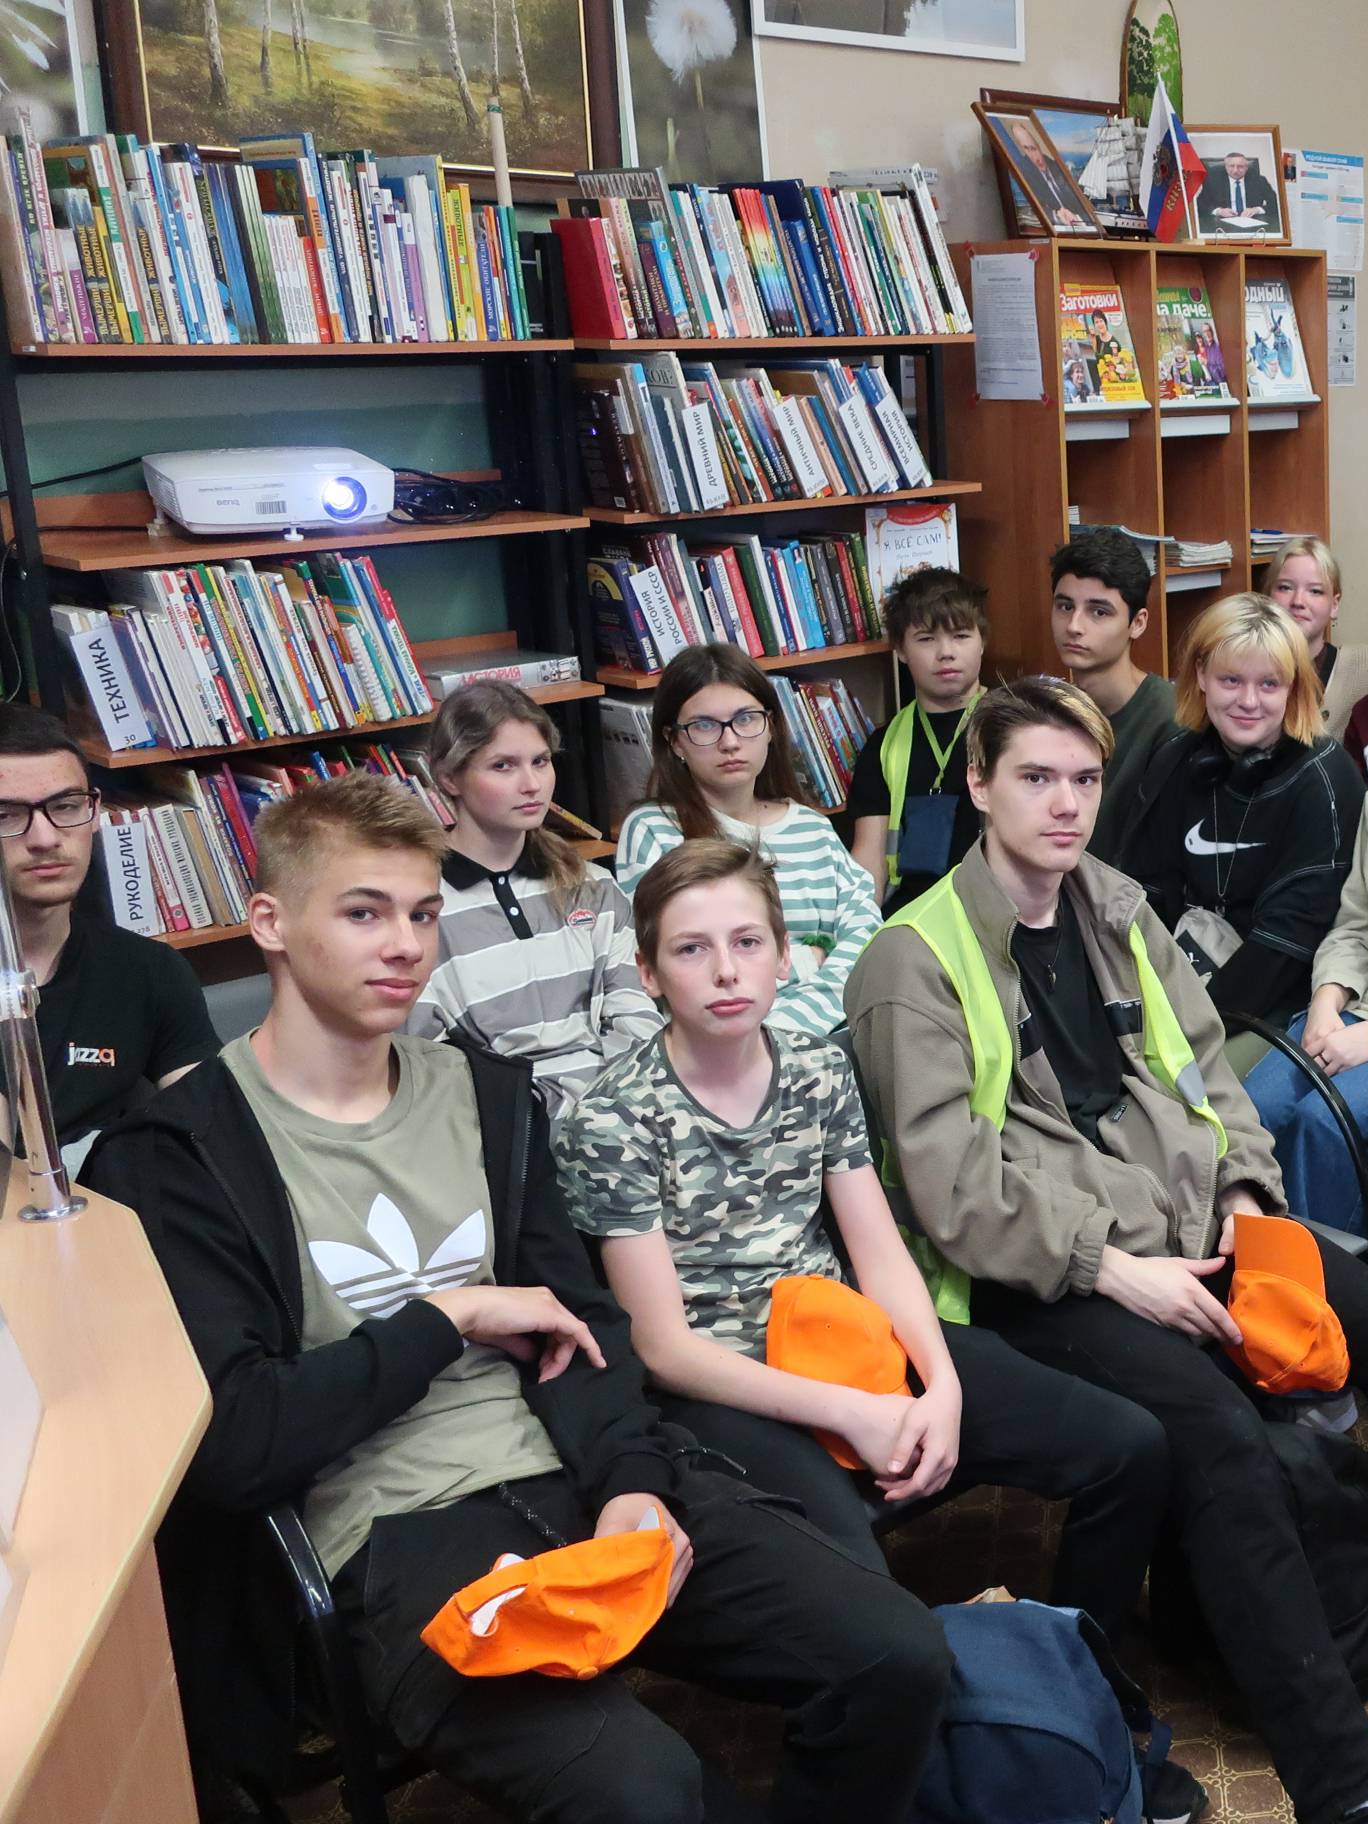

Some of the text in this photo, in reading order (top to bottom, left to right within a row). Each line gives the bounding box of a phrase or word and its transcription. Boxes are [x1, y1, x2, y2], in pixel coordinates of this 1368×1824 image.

[1060, 293, 1118, 311] Заготовки
[1245, 284, 1285, 303] ОДНЫЙ
[691, 410, 705, 436] МИР
[781, 405, 817, 477] АНТИЧНЫЙ МИР
[845, 404, 880, 471] СРЕДНИЕ ВЕКА
[880, 409, 911, 465] ВСЕМИРНАЯ
[891, 410, 914, 451] ИСТОРИЯ
[697, 437, 718, 488] ДРЕВНИЙ
[647, 570, 663, 595] СССР
[641, 590, 665, 637] ИСТОРИЯ
[662, 605, 682, 645] РОССИИ
[87, 638, 131, 724] ТЕХНИКА
[116, 826, 144, 921] РУКОДЕЛИЕ
